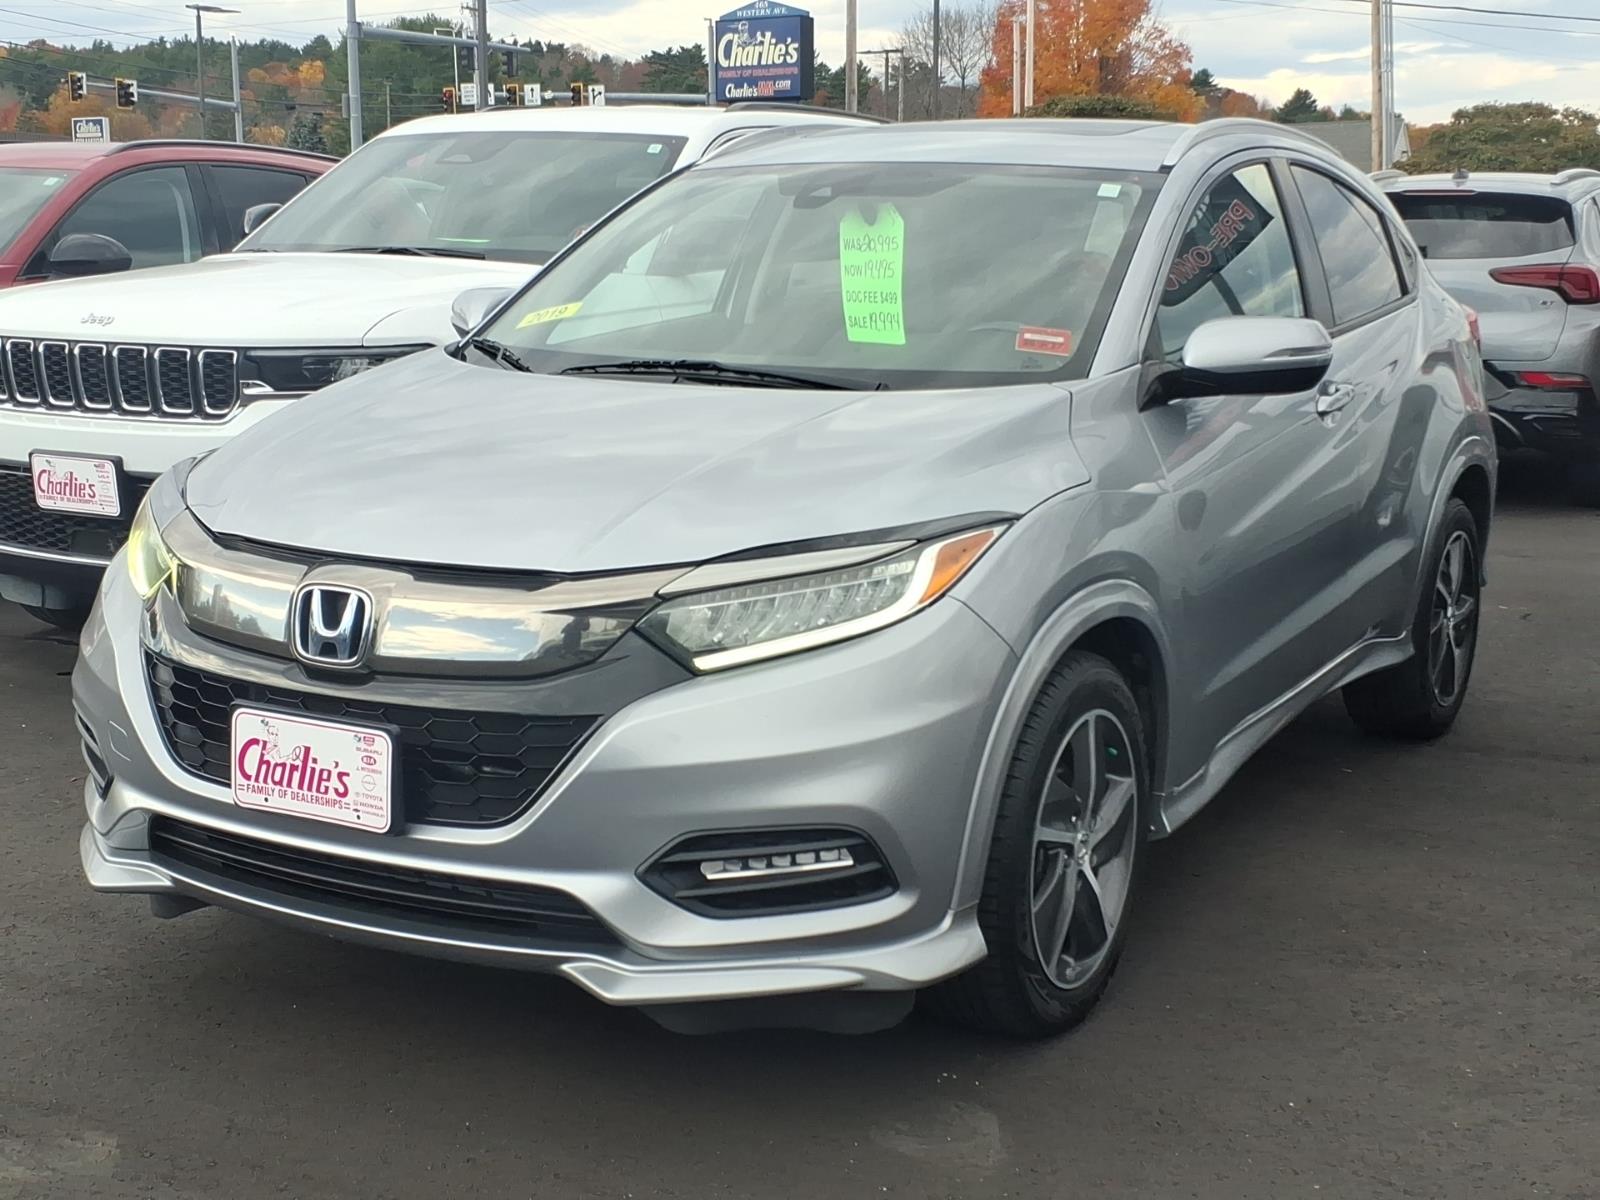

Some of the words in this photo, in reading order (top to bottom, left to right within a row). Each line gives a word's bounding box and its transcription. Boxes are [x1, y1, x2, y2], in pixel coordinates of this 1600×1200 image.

[736, 8, 771, 17] WESTERN
[718, 31, 799, 68] Charlie's
[742, 69, 752, 78] OF
[843, 237, 860, 251] WAS
[844, 264, 863, 277] NOW
[846, 290, 862, 303] DOC
[863, 291, 878, 304] FEE
[80, 312, 115, 327] Jeep
[525, 306, 569, 323] 2019
[848, 315, 868, 329] SALE
[37, 469, 96, 499] Charlie's
[238, 737, 350, 799] Charlie's
[246, 784, 275, 797] FAMILY
[278, 789, 289, 799] OF
[290, 791, 344, 808] DEALERSHIPS
[362, 793, 383, 802] TOYOTA
[359, 801, 384, 811] HONDA
